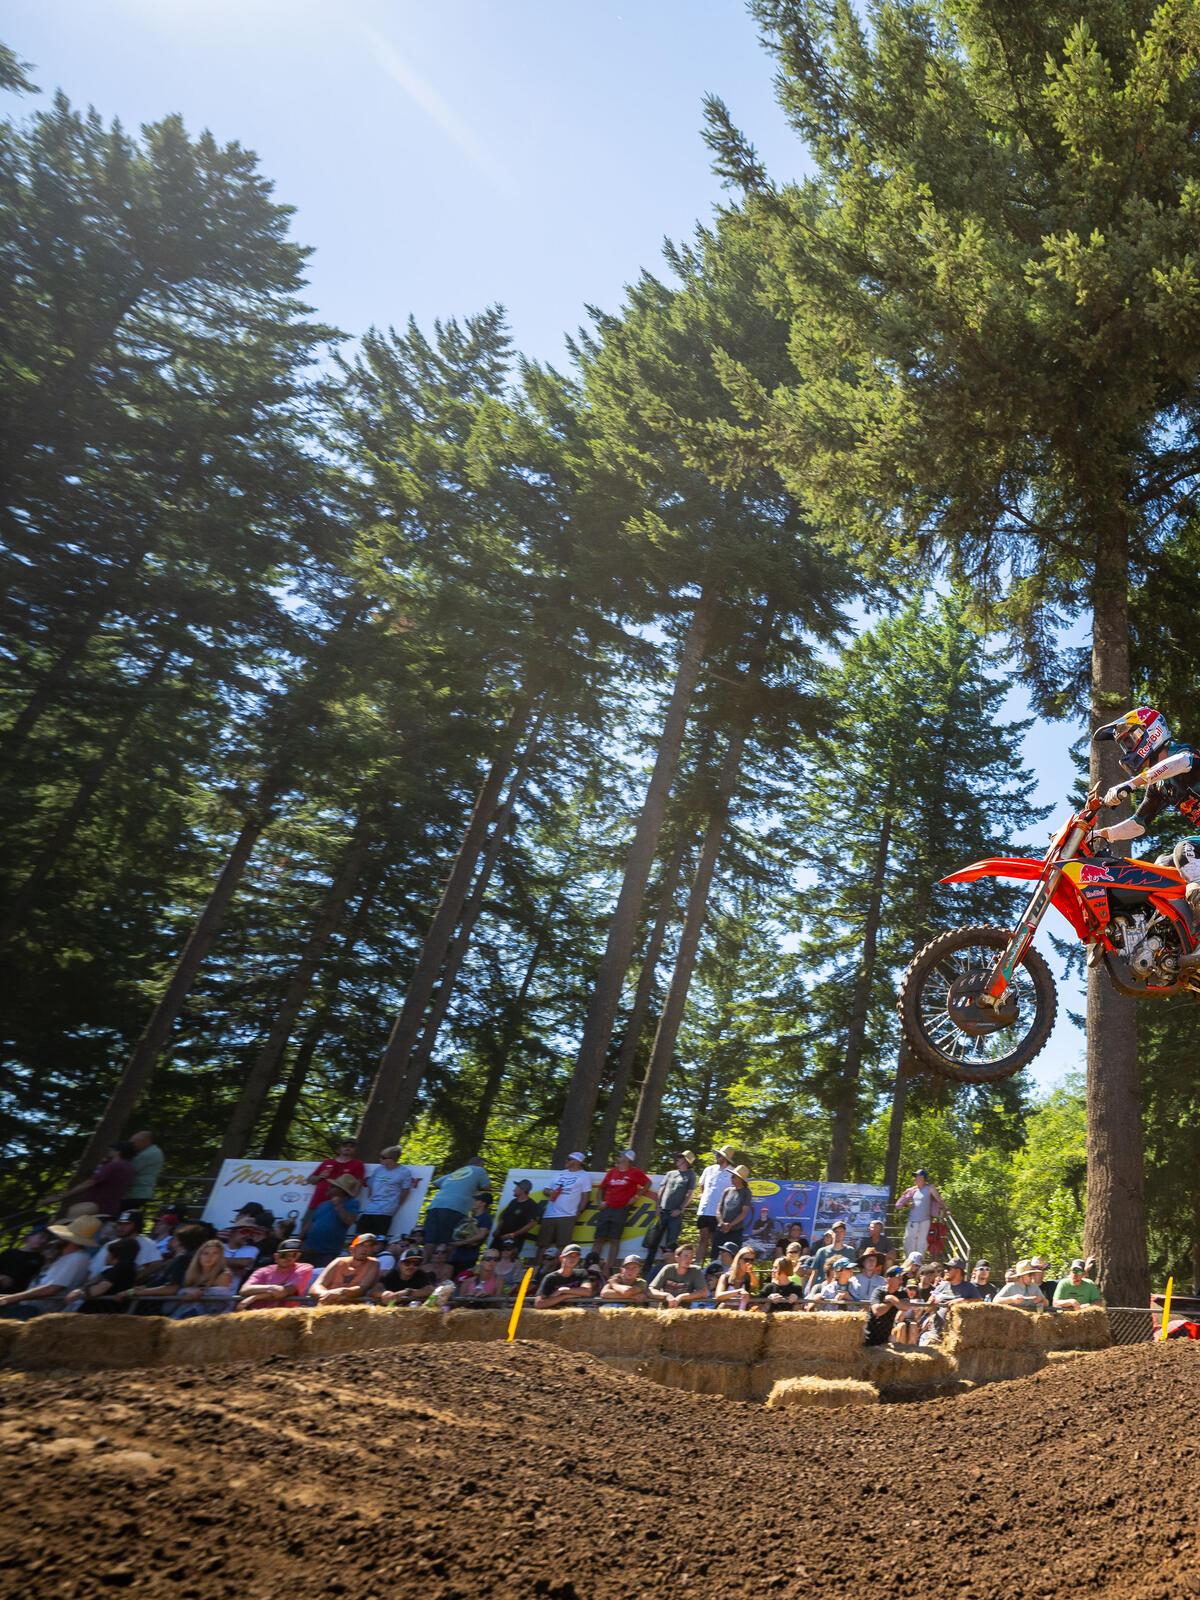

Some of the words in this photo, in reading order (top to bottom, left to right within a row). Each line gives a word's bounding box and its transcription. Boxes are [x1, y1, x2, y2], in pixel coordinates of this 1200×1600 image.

[1137, 738, 1154, 758] Red
[1150, 725, 1164, 742] Bull
[1157, 764, 1169, 776] Bull
